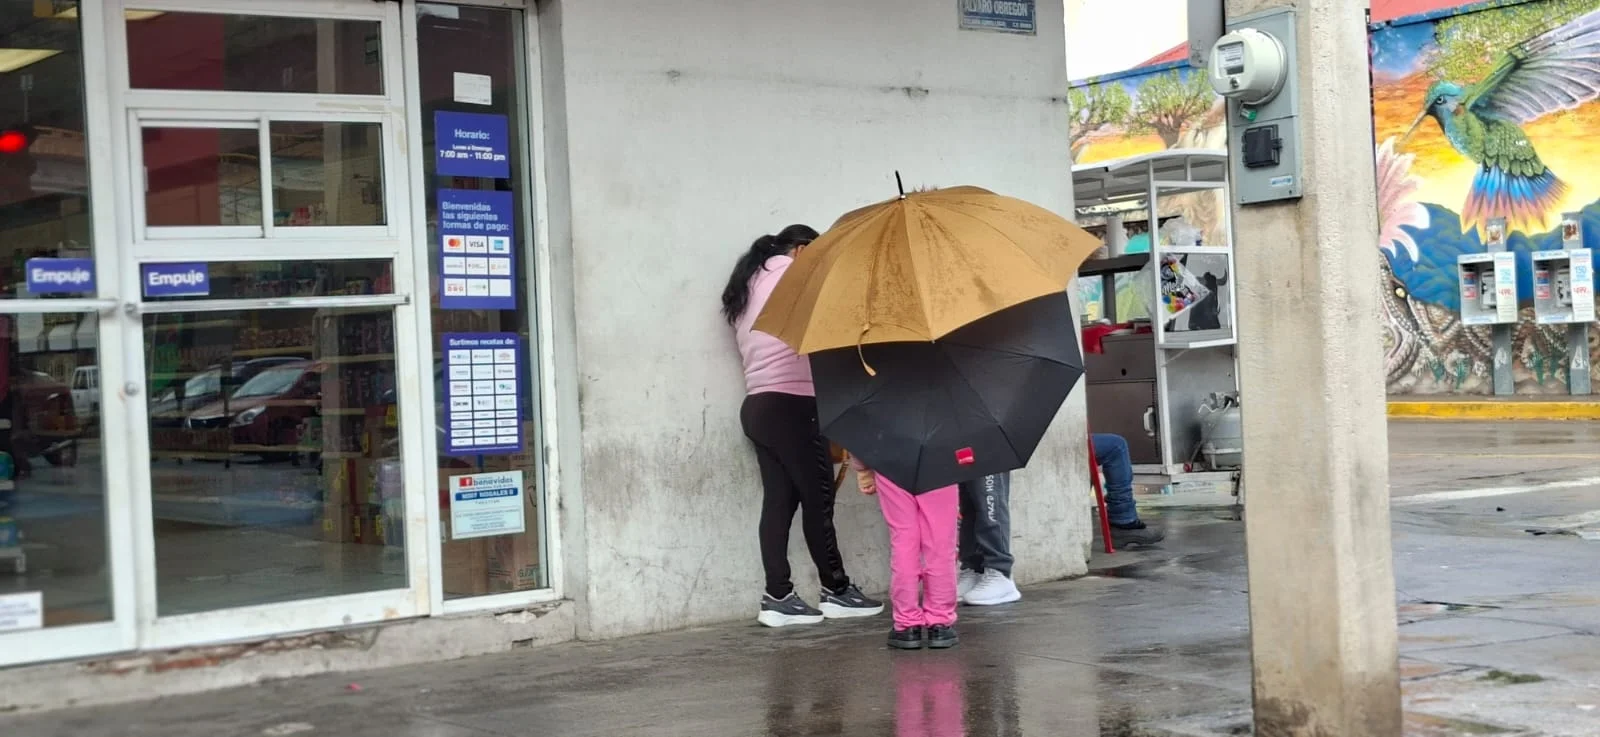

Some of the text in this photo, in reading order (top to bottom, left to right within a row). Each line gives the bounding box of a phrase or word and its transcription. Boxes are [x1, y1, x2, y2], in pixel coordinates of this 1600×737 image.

[454, 129, 490, 140] Horario:
[440, 150, 455, 158] 7:00
[475, 152, 493, 160] 11:00
[442, 211, 498, 222] las siguientes
[442, 221, 510, 232] formas de pago:
[31, 268, 91, 285] Empuje
[148, 269, 205, 286] Empuje
[449, 338, 479, 346] Surtimos
